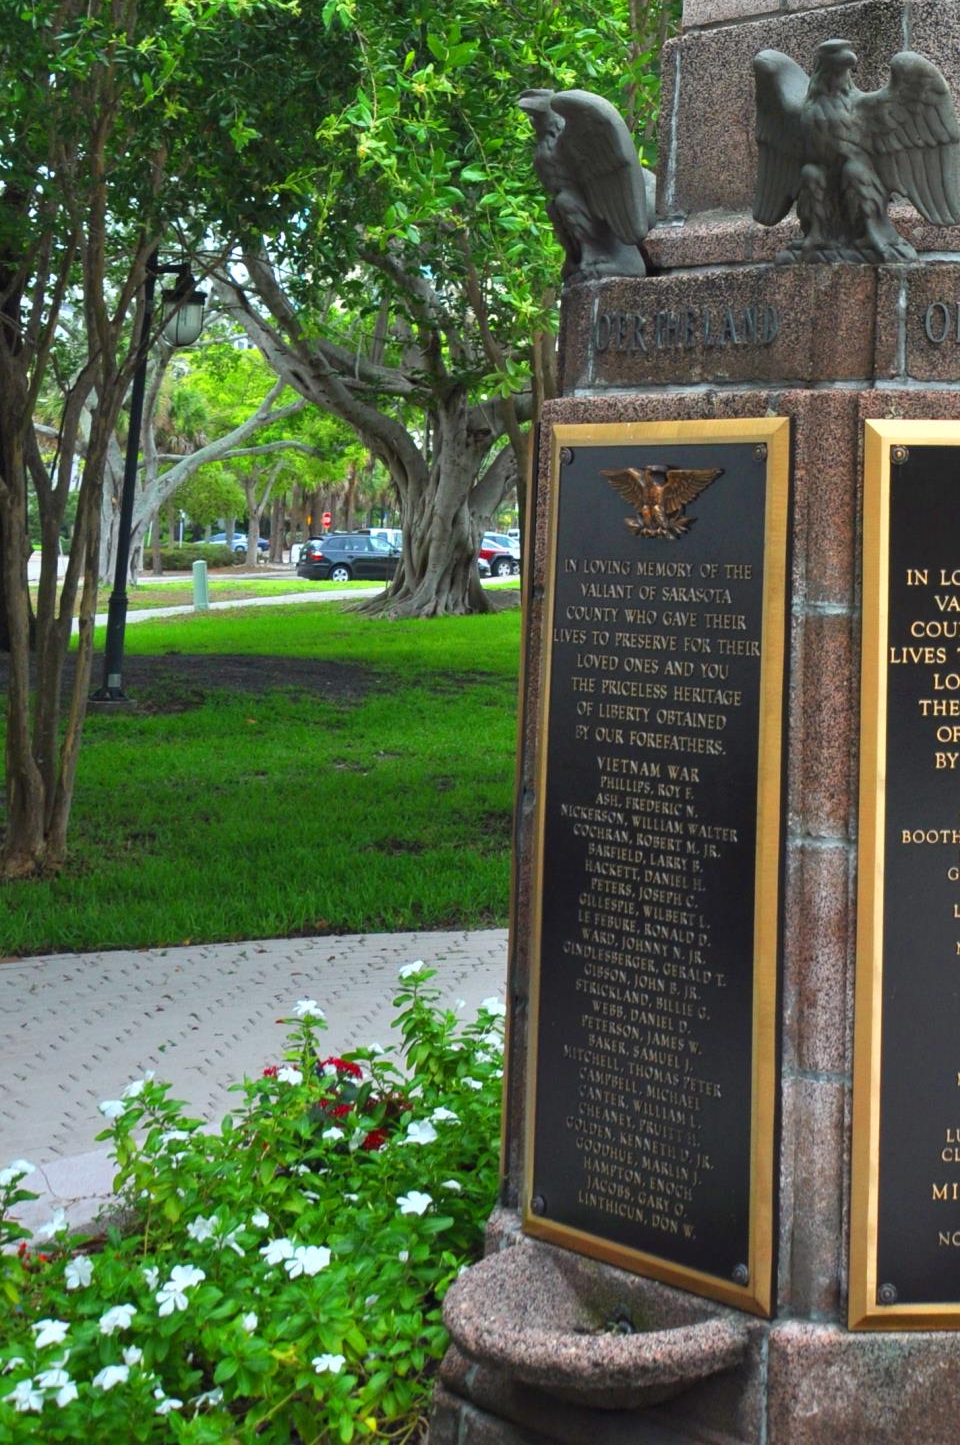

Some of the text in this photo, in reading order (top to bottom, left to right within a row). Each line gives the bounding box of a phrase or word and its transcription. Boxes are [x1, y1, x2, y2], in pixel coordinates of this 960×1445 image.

[656, 309, 696, 349] THE
[704, 305, 780, 345] LAND
[565, 559, 751, 579] IN LOVING MEMORY OF THE
[907, 569, 928, 585] IN
[581, 583, 731, 603] VALIANT OF SARASOTA
[566, 606, 746, 630] COUNTY WHO GAVE THEIR
[555, 628, 759, 656] LIVES TO PRESERVE FOR THEIR
[577, 654, 728, 679] LOVED ONES AND YOU
[891, 647, 946, 663] LIVES
[571, 677, 741, 706] THE PRICELESS HERITAGE
[577, 701, 726, 729] OF LIBERTY OBTAINED
[918, 699, 959, 715] THE
[576, 725, 726, 755] BY OUR FOREFATHERS.
[597, 756, 699, 782] VIETNAM WAR
[935, 752, 959, 768] BY
[600, 775, 694, 799] PHILLIPS, ROY F.
[595, 792, 698, 818] ASH, FREDERIC N.
[584, 1156, 692, 1201] HAMPTON, ENOCH
